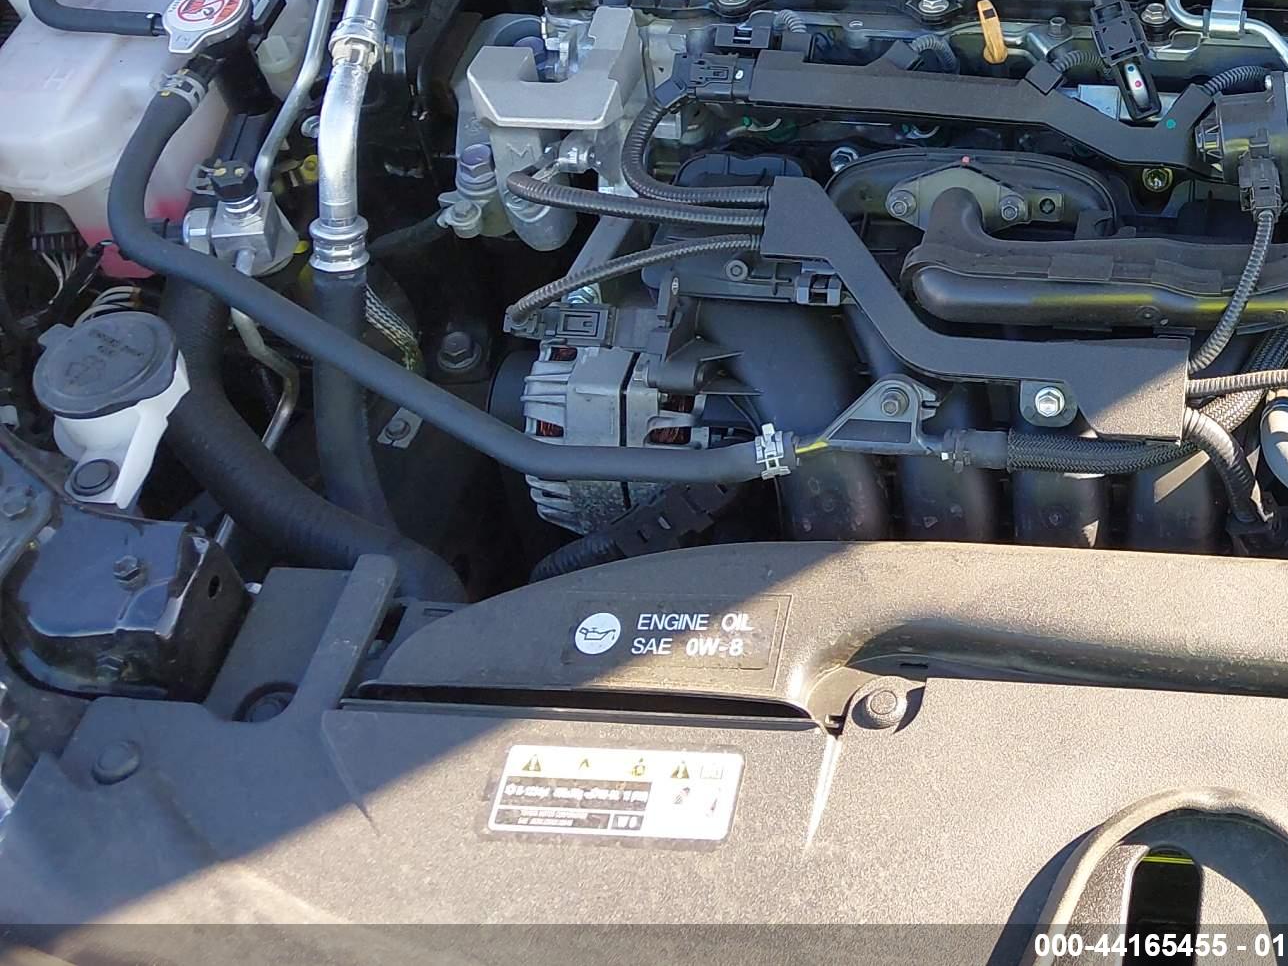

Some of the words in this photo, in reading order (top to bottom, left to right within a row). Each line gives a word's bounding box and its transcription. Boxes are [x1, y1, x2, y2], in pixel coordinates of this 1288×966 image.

[637, 613, 710, 631] ENGINE
[721, 613, 754, 632] OIL
[631, 638, 673, 655] SAE
[685, 638, 743, 657] 0W-8
